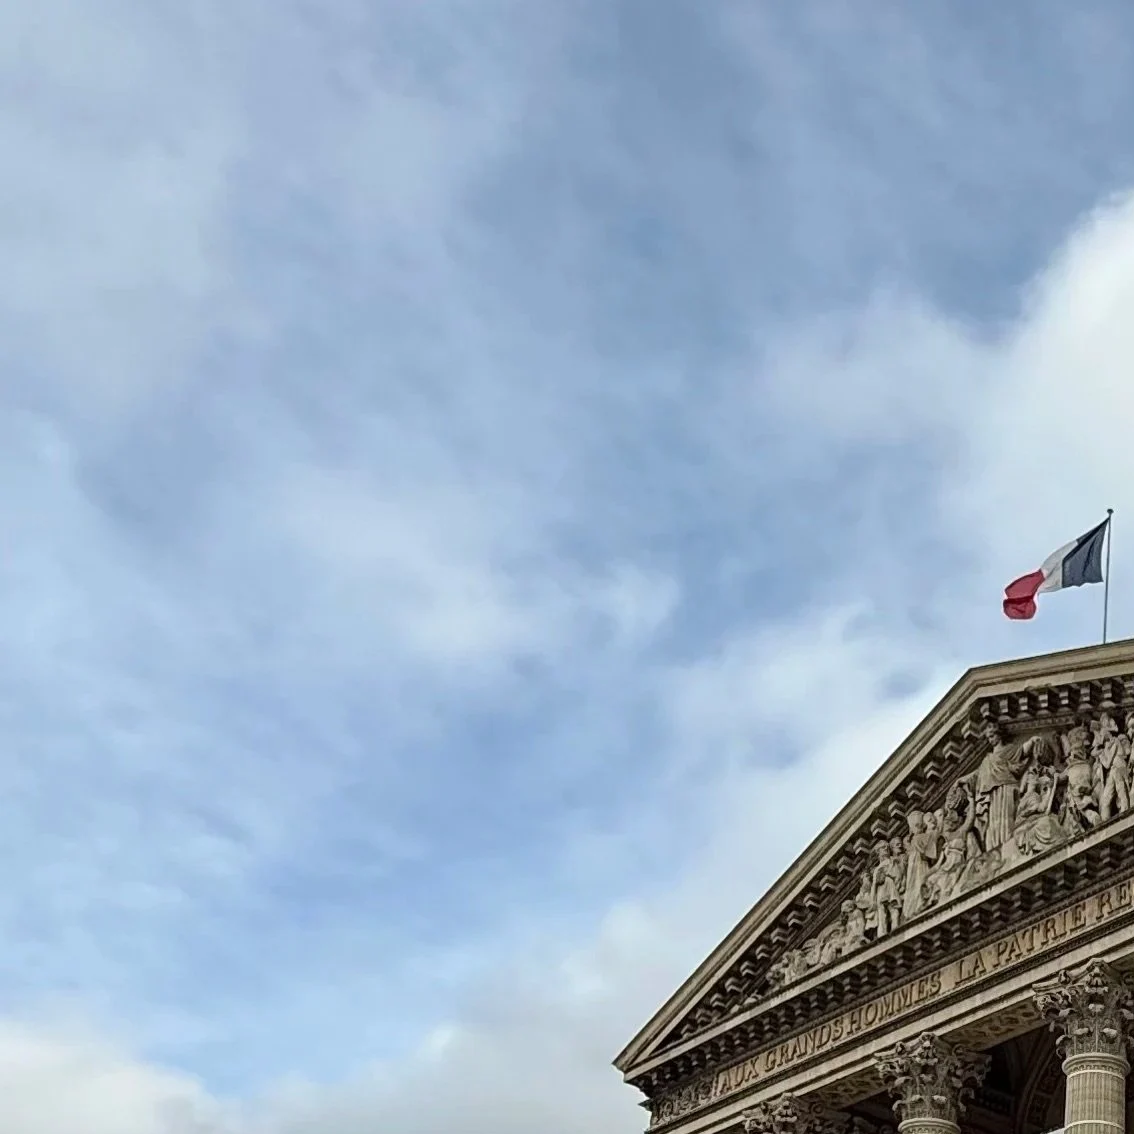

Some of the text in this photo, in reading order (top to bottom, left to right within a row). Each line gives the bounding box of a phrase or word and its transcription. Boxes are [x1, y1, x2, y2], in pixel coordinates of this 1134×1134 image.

[719, 1056, 760, 1094] AUX
[764, 1017, 844, 1073] GRANDS
[847, 971, 942, 1034] HOMMES
[955, 951, 986, 985] LA
[993, 902, 1087, 968] PATRIE
